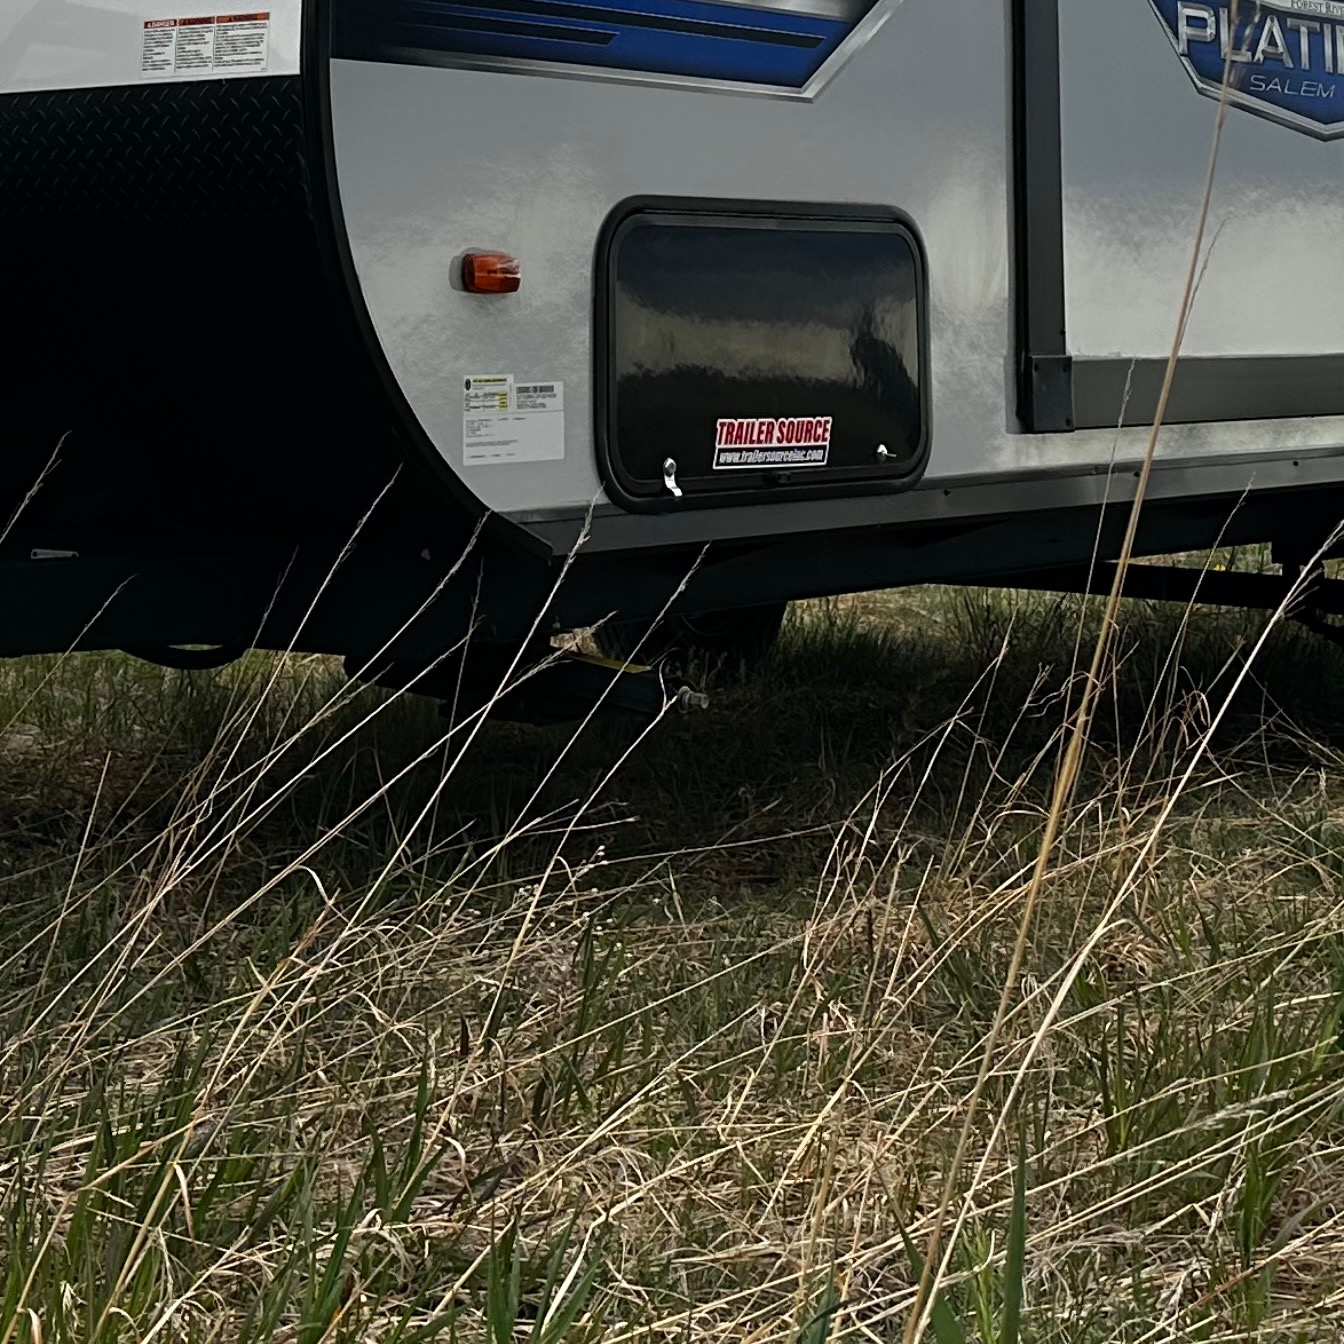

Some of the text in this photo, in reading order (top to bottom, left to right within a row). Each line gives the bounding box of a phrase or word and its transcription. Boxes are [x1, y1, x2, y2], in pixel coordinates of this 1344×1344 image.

[1249, 74, 1336, 99] SALEM
[717, 418, 830, 446] TRAILER SOURCE
